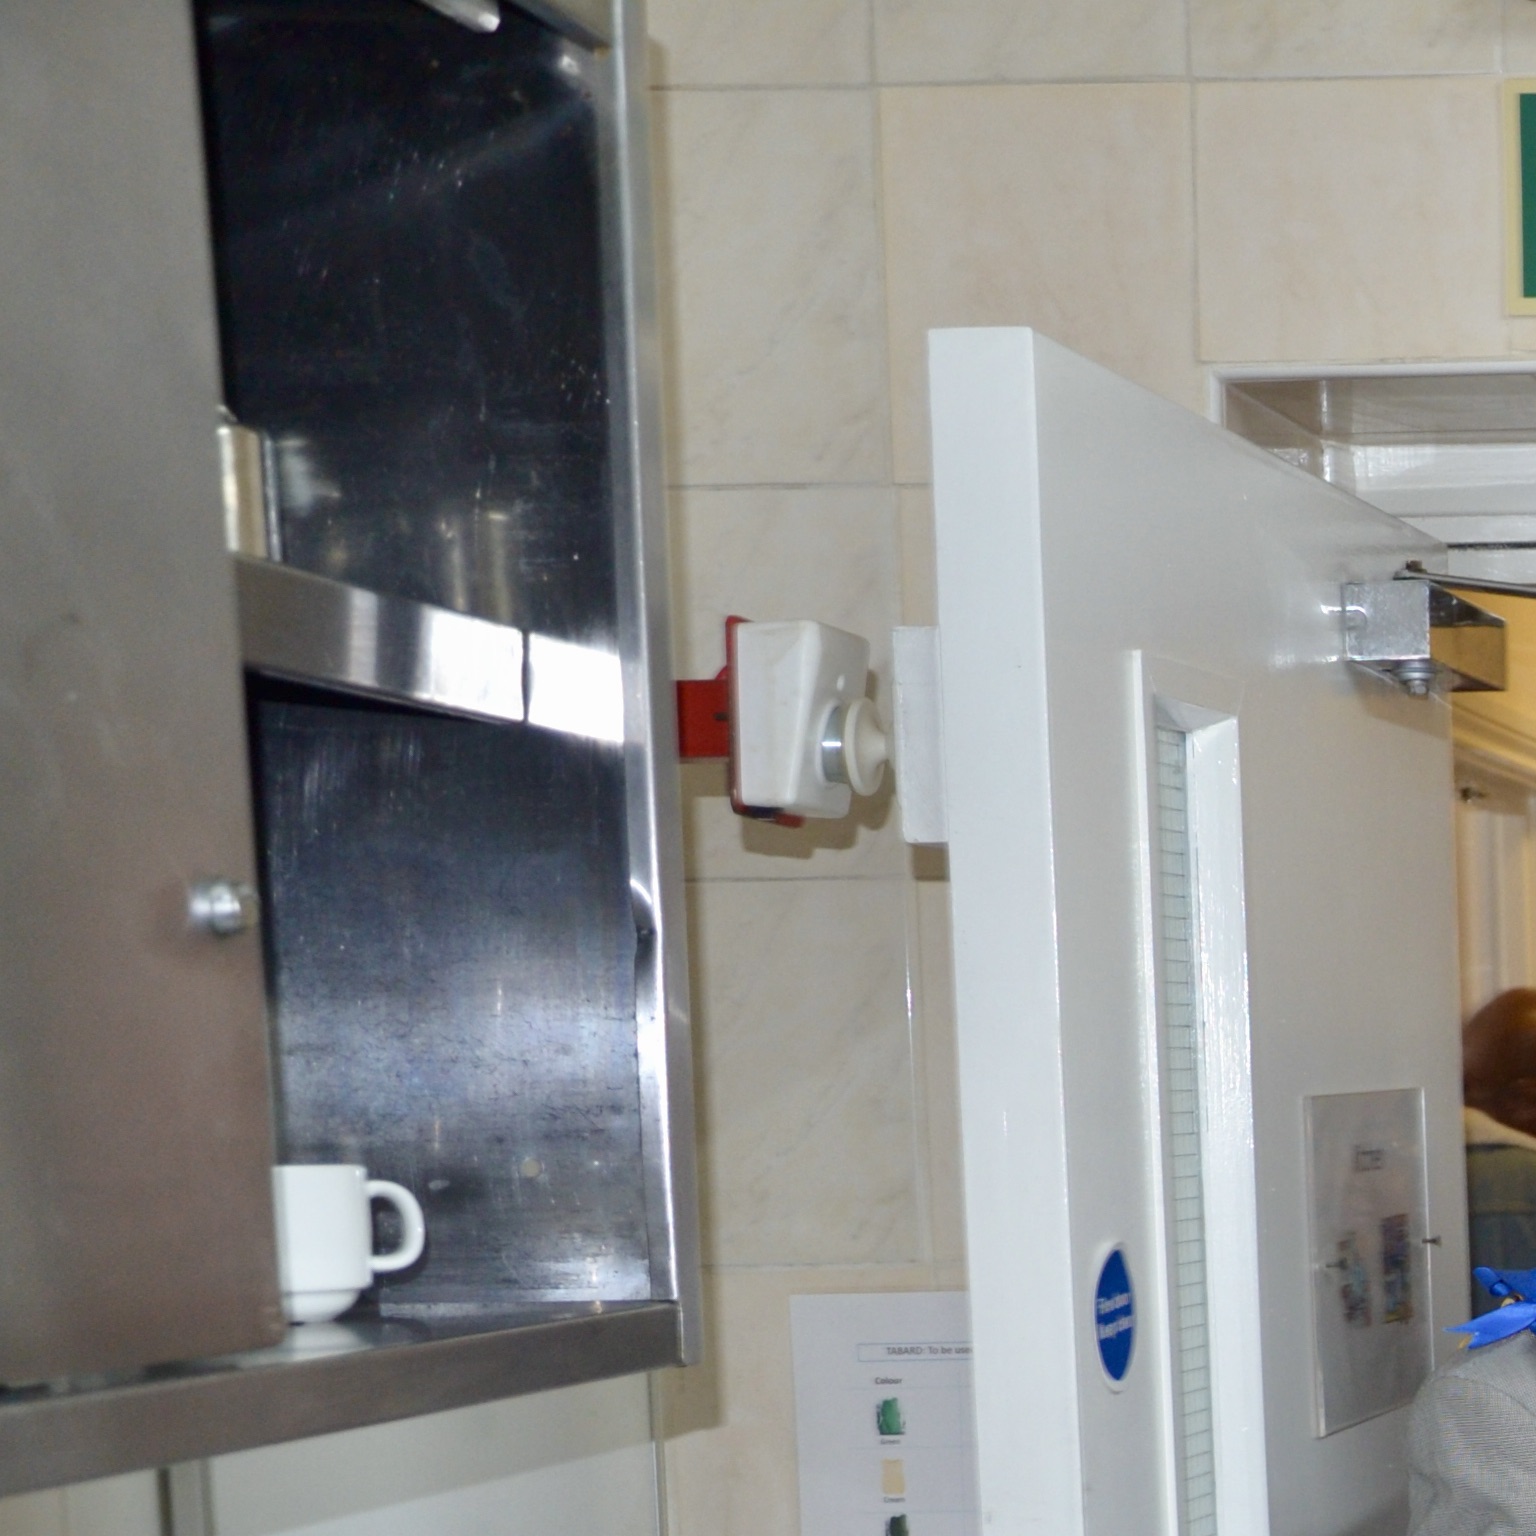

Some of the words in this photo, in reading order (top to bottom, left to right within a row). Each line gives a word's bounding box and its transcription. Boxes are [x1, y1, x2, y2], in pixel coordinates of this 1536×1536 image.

[928, 1346, 938, 1355] To
[940, 1346, 953, 1355] be
[874, 1376, 903, 1385] Colour
